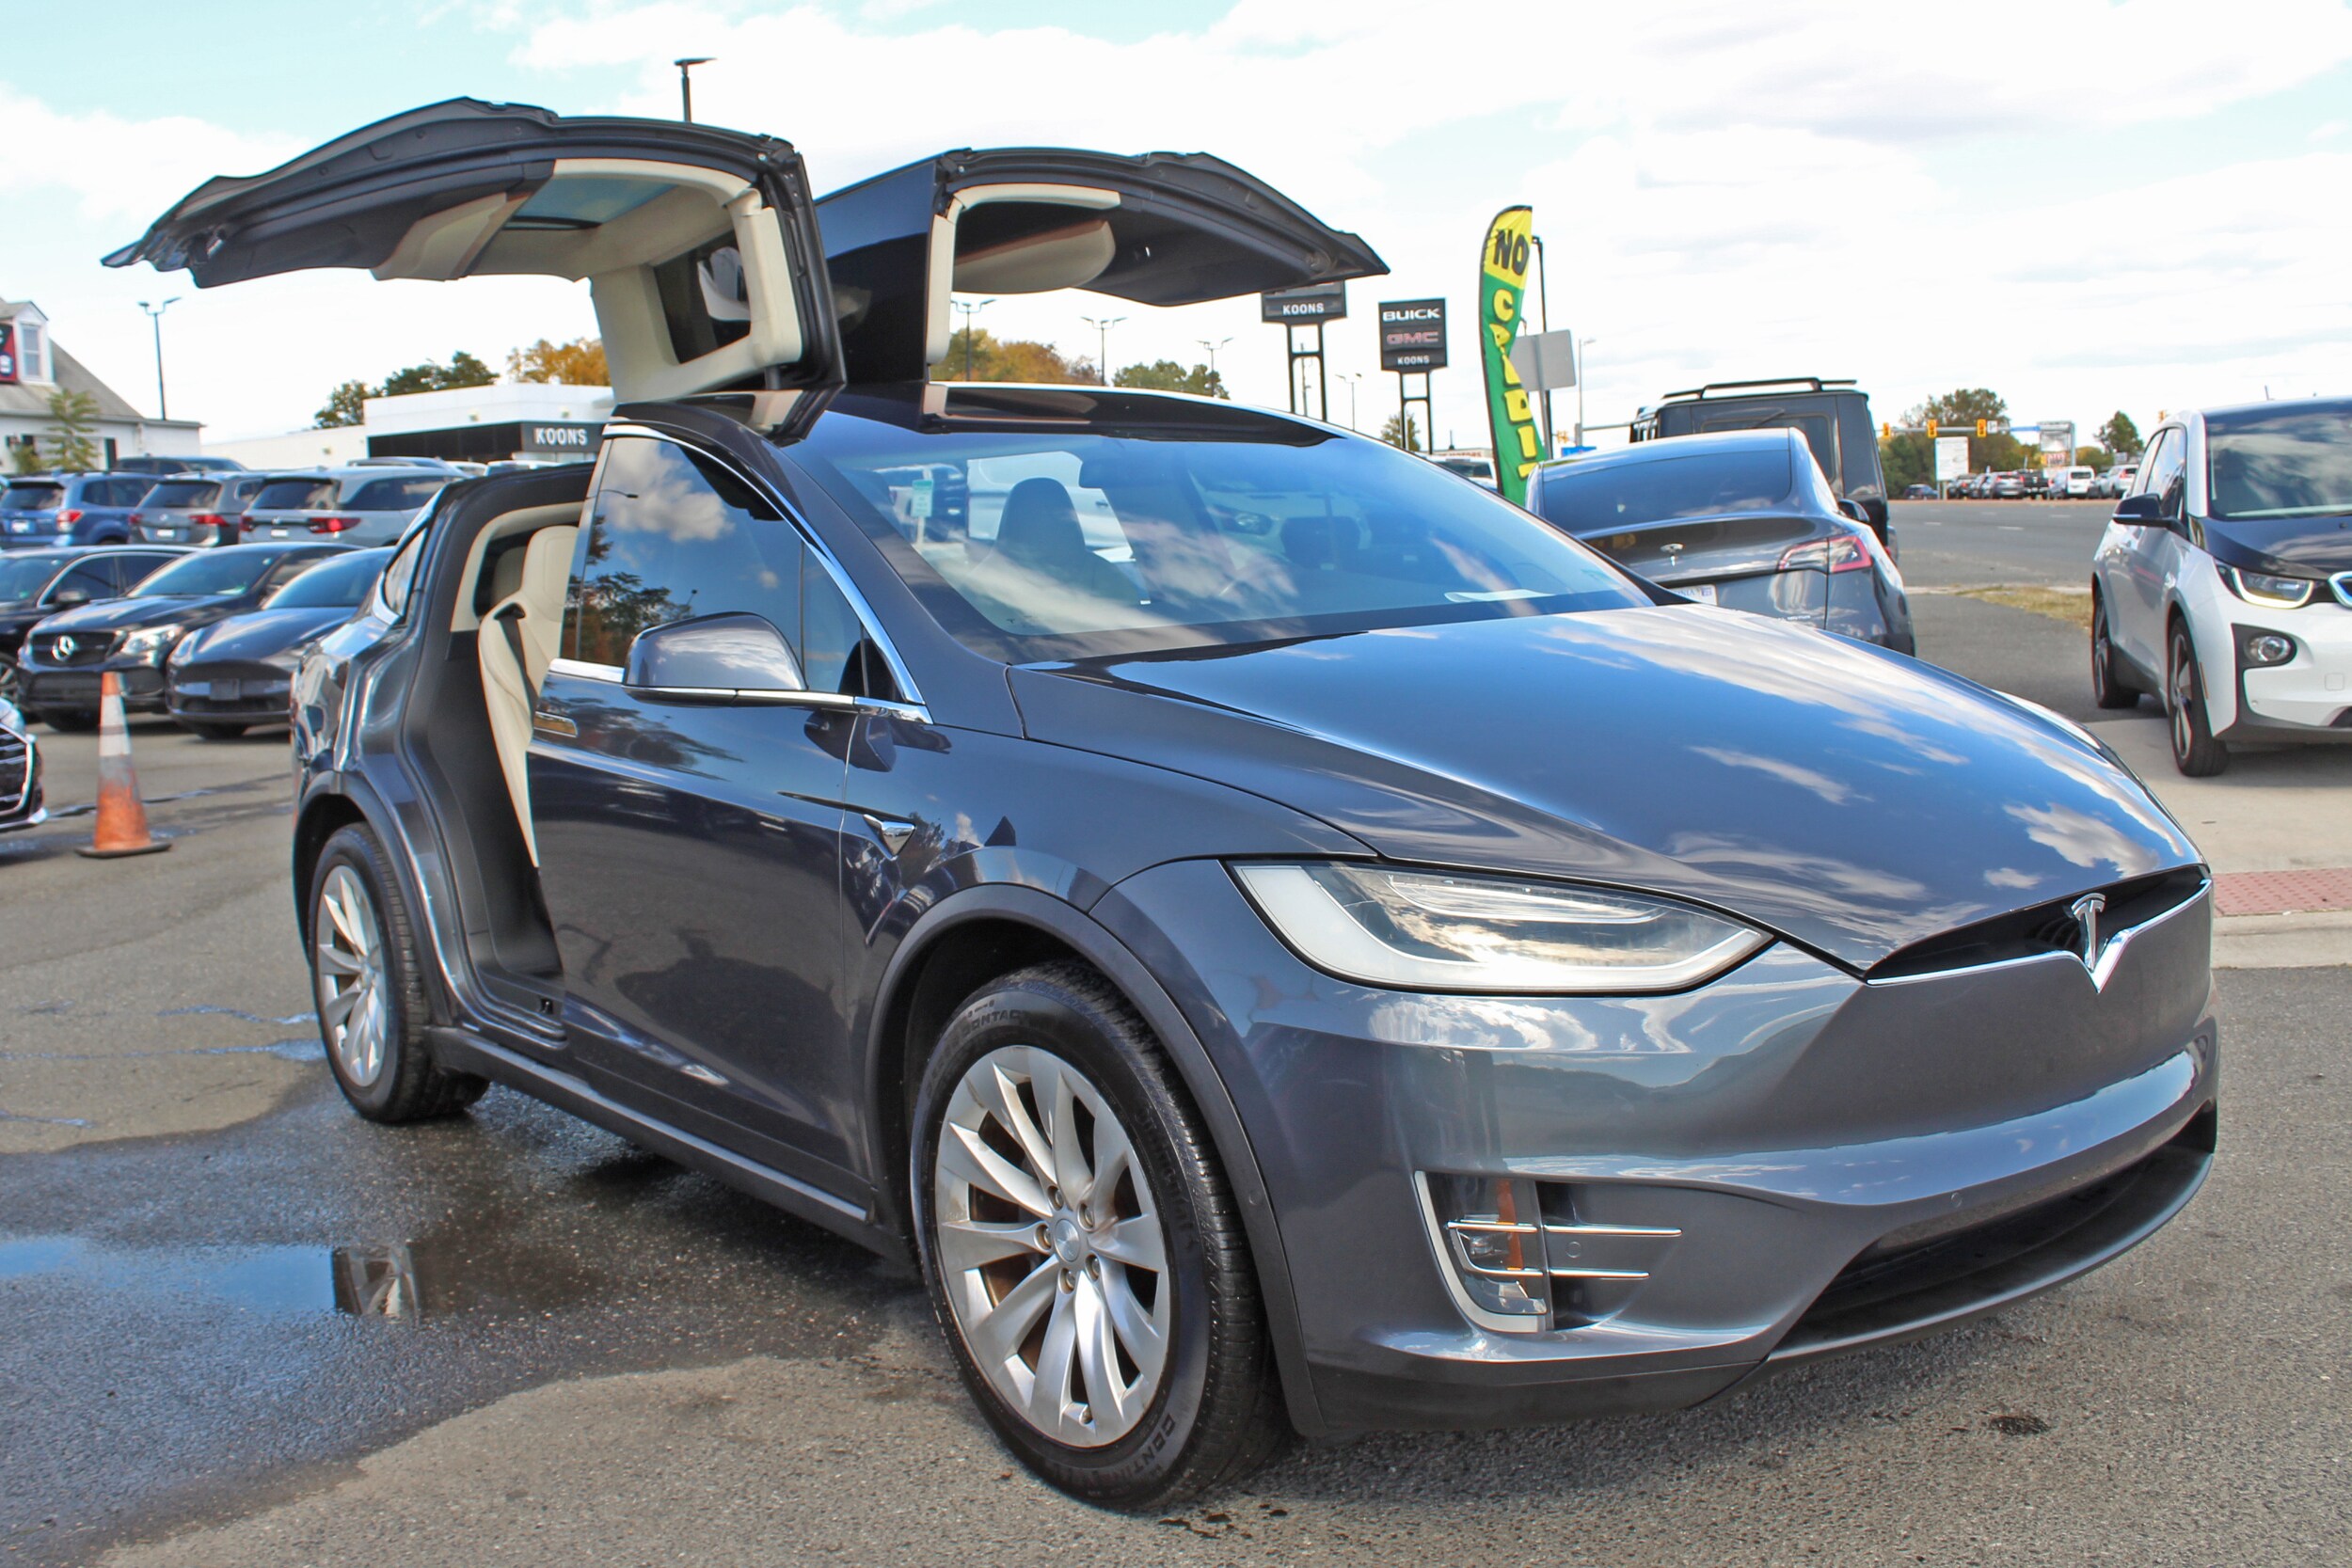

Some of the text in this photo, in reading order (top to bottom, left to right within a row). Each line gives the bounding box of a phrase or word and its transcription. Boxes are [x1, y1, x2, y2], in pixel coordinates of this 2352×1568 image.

[1493, 229, 1530, 277] NO
[1282, 303, 1325, 316] KOONS
[1382, 308, 1440, 322] BUICK
[1387, 331, 1438, 344] GMC
[1397, 356, 1430, 365] KOONS
[533, 427, 588, 446] KOONS
